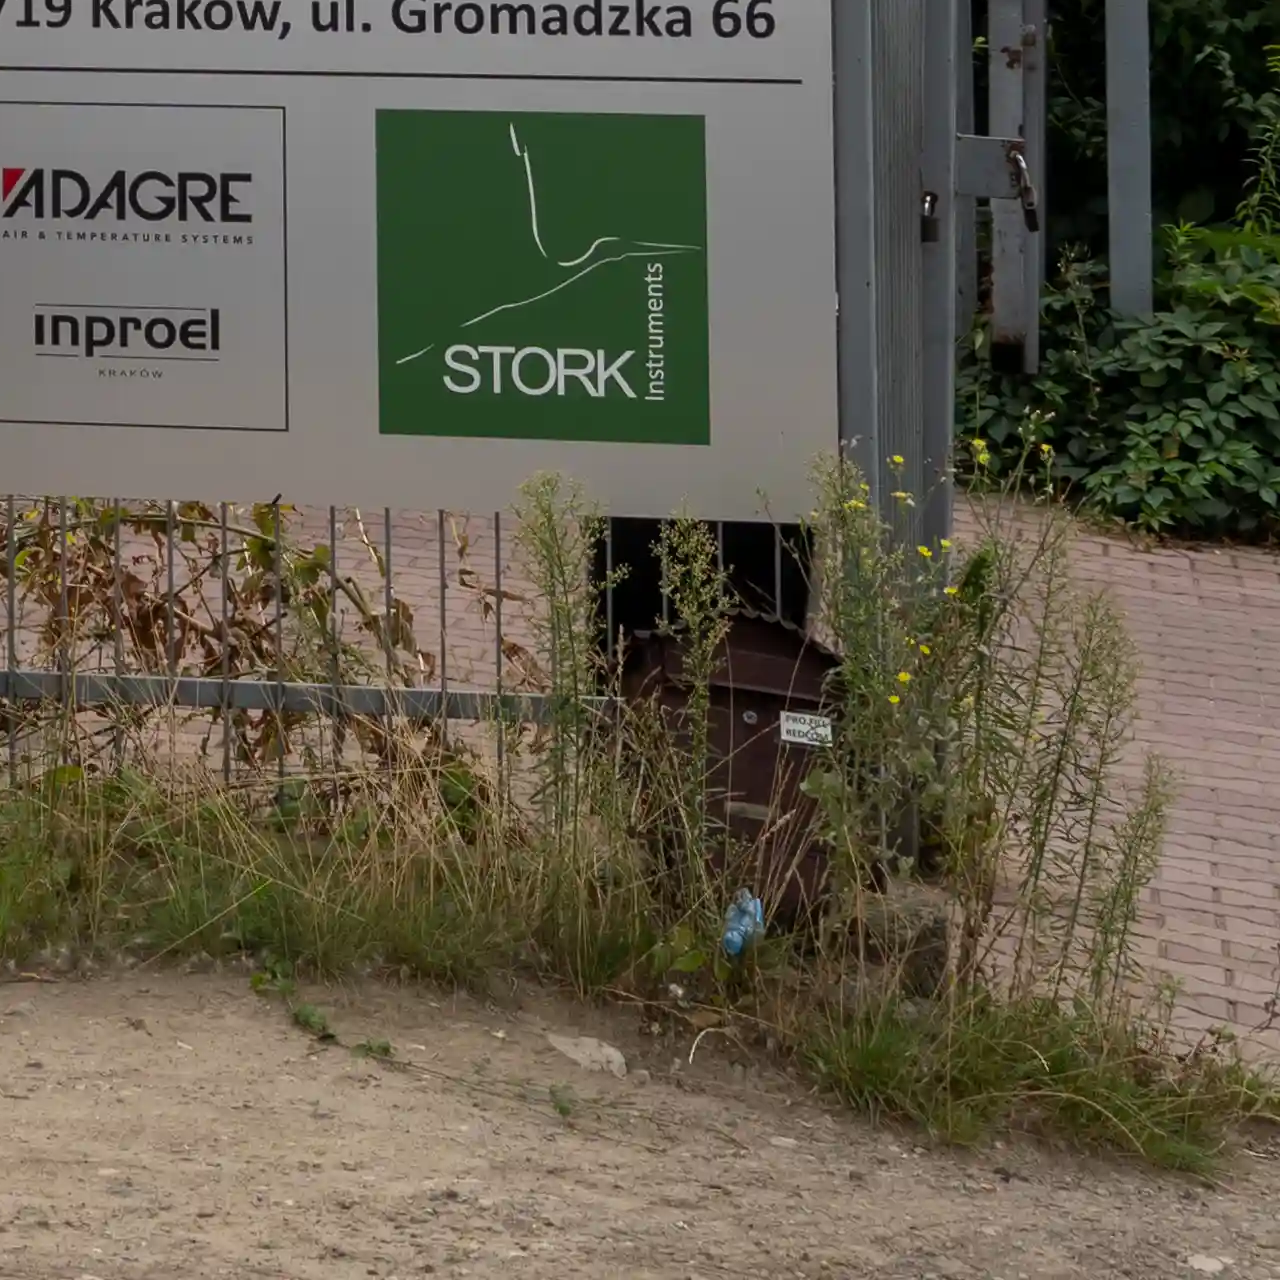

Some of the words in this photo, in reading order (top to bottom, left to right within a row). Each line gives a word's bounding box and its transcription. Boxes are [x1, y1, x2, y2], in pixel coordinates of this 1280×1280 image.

[2, 167, 253, 223] ADAGRE
[2, 230, 29, 240] AIR
[38, 230, 46, 240] &
[57, 230, 172, 243] TEMPERATURE
[181, 233, 254, 245] SYSTEMS
[644, 262, 665, 401] Instruments
[97, 366, 164, 379] KRAKÓW
[443, 344, 638, 399] STORK
